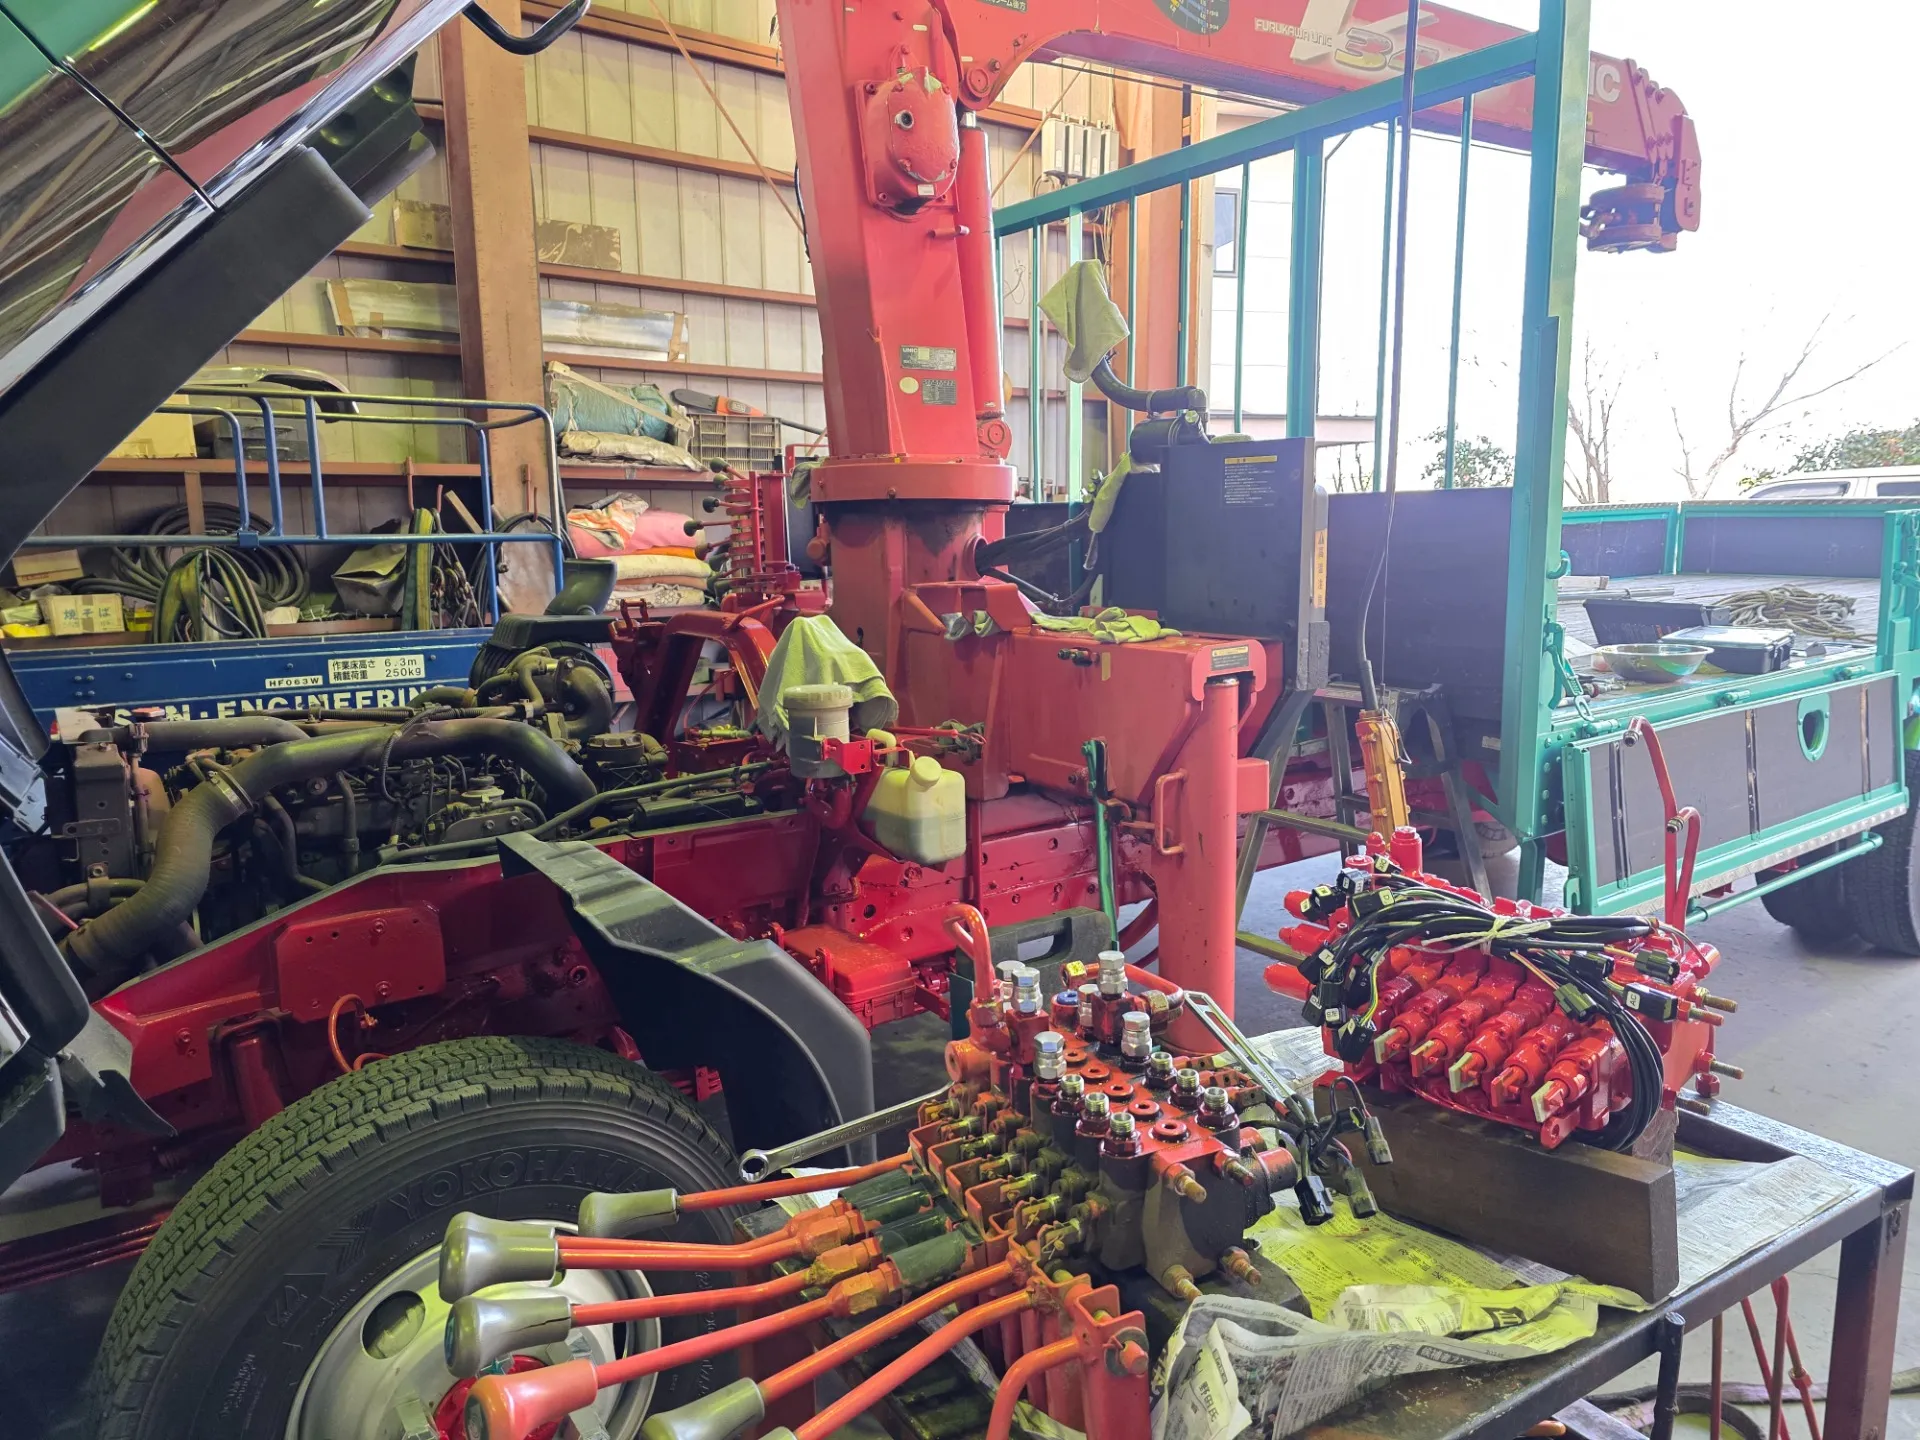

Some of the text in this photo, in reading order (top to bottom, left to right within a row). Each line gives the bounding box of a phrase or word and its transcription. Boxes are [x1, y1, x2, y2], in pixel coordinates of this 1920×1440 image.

[1254, 17, 1333, 48] FURUKAWA UNIC
[332, 658, 417, 671] 作業床高さ 6.3m
[333, 667, 421, 681] 積載荷重 250kg
[269, 678, 319, 687] HF063W
[1629, 995, 1637, 1007] AC
[390, 1149, 651, 1220] YOKOHAMA
